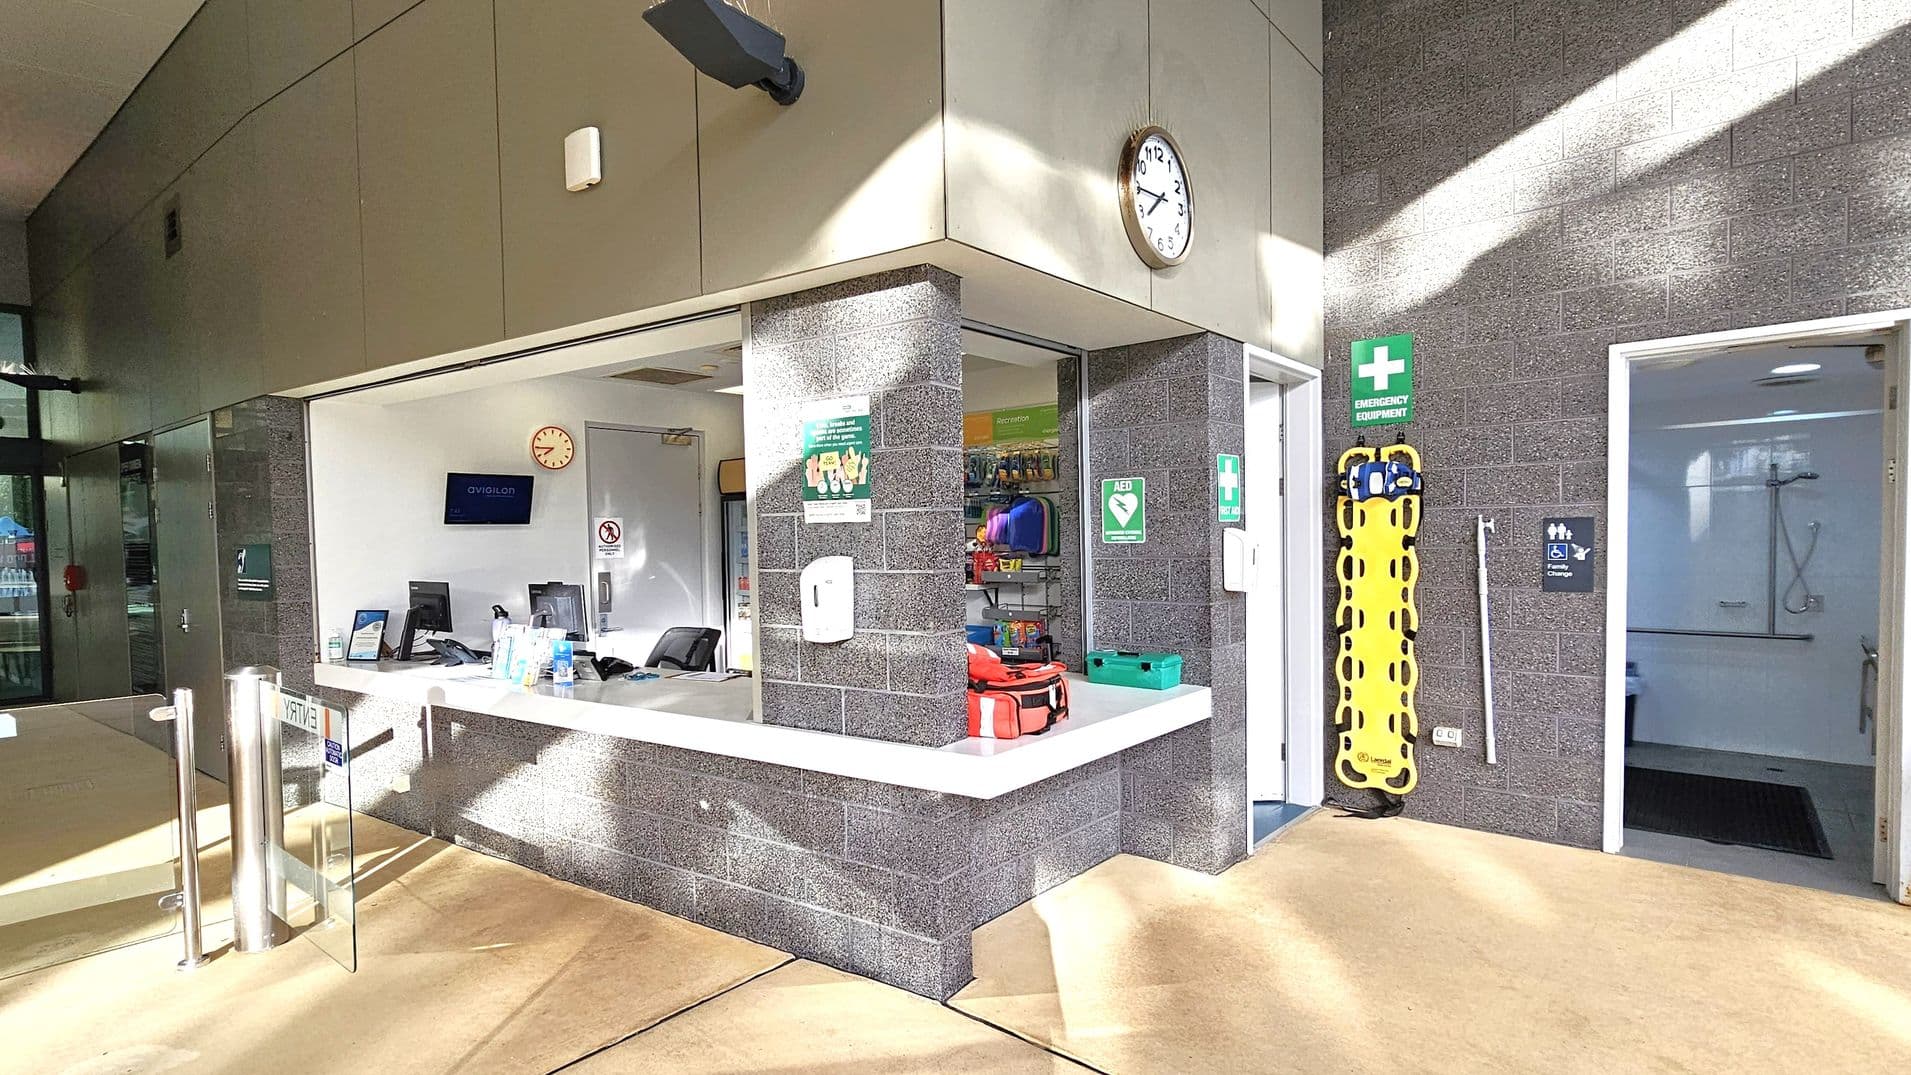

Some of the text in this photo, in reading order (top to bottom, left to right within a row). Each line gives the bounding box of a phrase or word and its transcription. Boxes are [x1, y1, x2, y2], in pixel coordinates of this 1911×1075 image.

[1145, 146, 1152, 162] 11
[1154, 146, 1163, 162] 12
[1137, 160, 1146, 175] 10
[1168, 160, 1172, 172] 1
[1174, 180, 1180, 194] 2
[1178, 202, 1184, 216] 3
[1147, 226, 1153, 239] 7
[1174, 222, 1180, 235] 4
[1158, 238, 1164, 251] 6
[1168, 236, 1174, 250] 5
[1354, 394, 1409, 409] EMERGENCY
[996, 414, 1030, 425] Recreation
[1356, 408, 1408, 421] EQUIPMENT
[1114, 480, 1132, 492] AED
